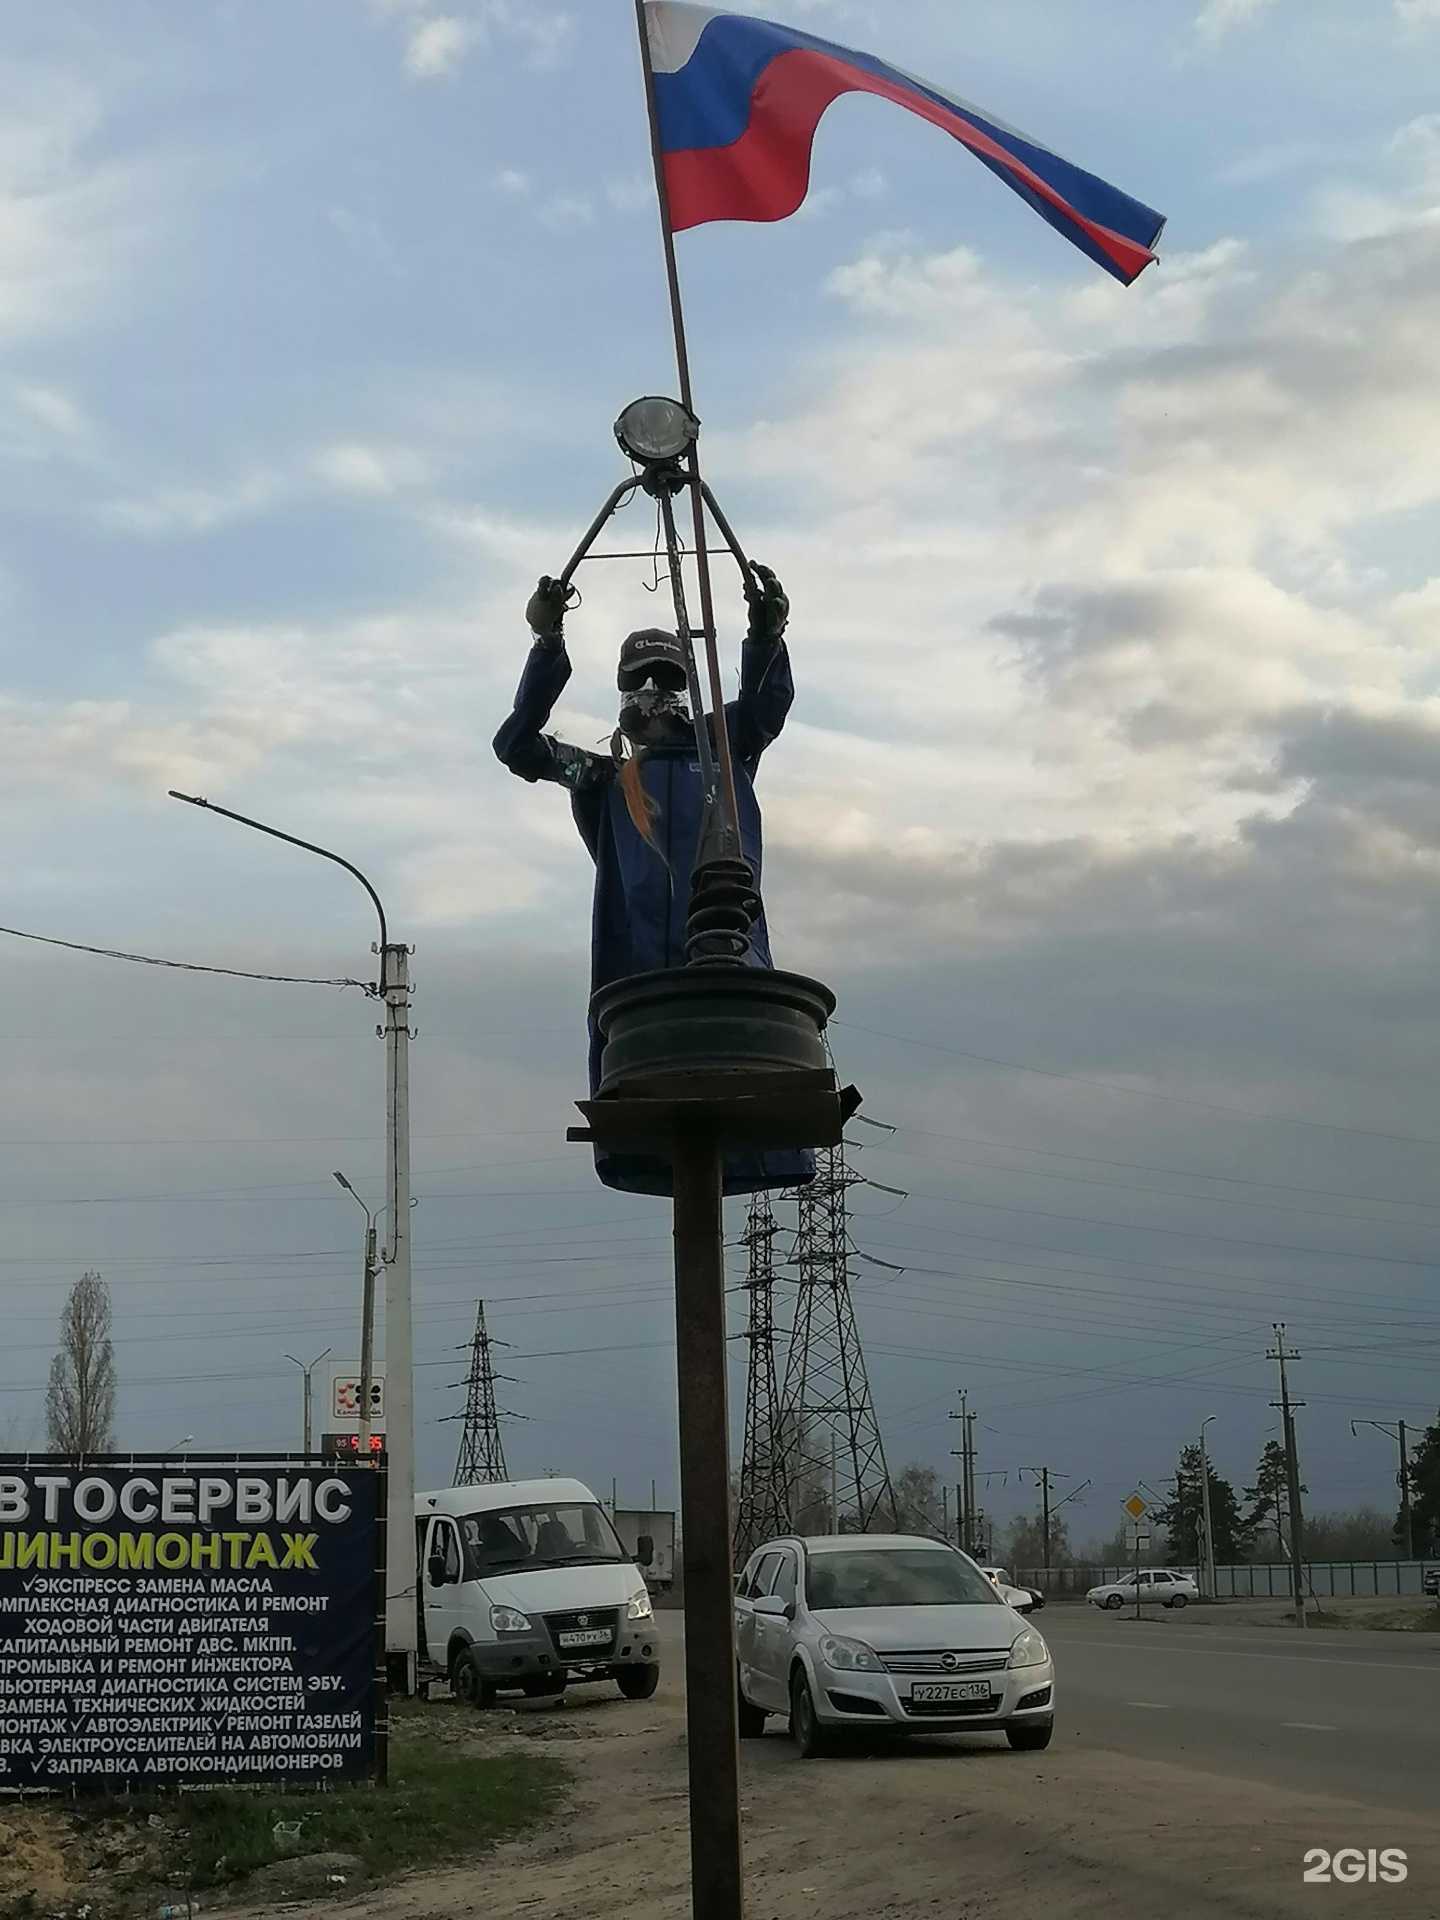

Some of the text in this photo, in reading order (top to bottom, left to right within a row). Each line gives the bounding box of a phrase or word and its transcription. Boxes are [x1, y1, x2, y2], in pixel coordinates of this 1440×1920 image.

[0, 1476, 352, 1524] ВТОСЕРВИС
[34, 1577, 273, 1594] ЭКСПРЕСС ЗАМЕНА МАСЛА
[0, 1596, 328, 1614] МПЛЕКСНАЯ ДИАГНОСТИКА И РЕМОНТ
[24, 1615, 268, 1636] ХОДОВОЙ ЧАСТИ ДВИГАТЕЛЯ
[125, 1638, 193, 1653] РЕМОНТ
[197, 1637, 237, 1655] ДВС.
[244, 1637, 296, 1652] МКПП.
[101, 1659, 112, 1673] И
[119, 1658, 186, 1673] РЕМОНТ
[192, 1656, 293, 1672] ИНЖЕКТОРА
[101, 1677, 228, 1695] ДИАГНОСТИКА
[234, 1676, 302, 1692] СИСТЕМ
[308, 1675, 345, 1691] ЭБУ.
[0, 1692, 304, 1714] ЗАМЕНА ТЕХНИЧЕСКИХ ЖИДКОСТЕЙ
[86, 1716, 212, 1734] АВТОЭЛЕКТРИК
[227, 1716, 292, 1731] РЕМОНТ
[297, 1711, 361, 1729] ГАЗЕЛЕЙ
[39, 1733, 216, 1753] ЭЛЕКТРОУСЕЛИТЕЛЕЙ
[222, 1736, 244, 1751] НА
[250, 1734, 361, 1750] АВТОМОБИЛИ
[48, 1758, 138, 1774] ЗАПРАВКА
[144, 1754, 343, 1773] АВТОКОНДИЦИОНЕРОВ
